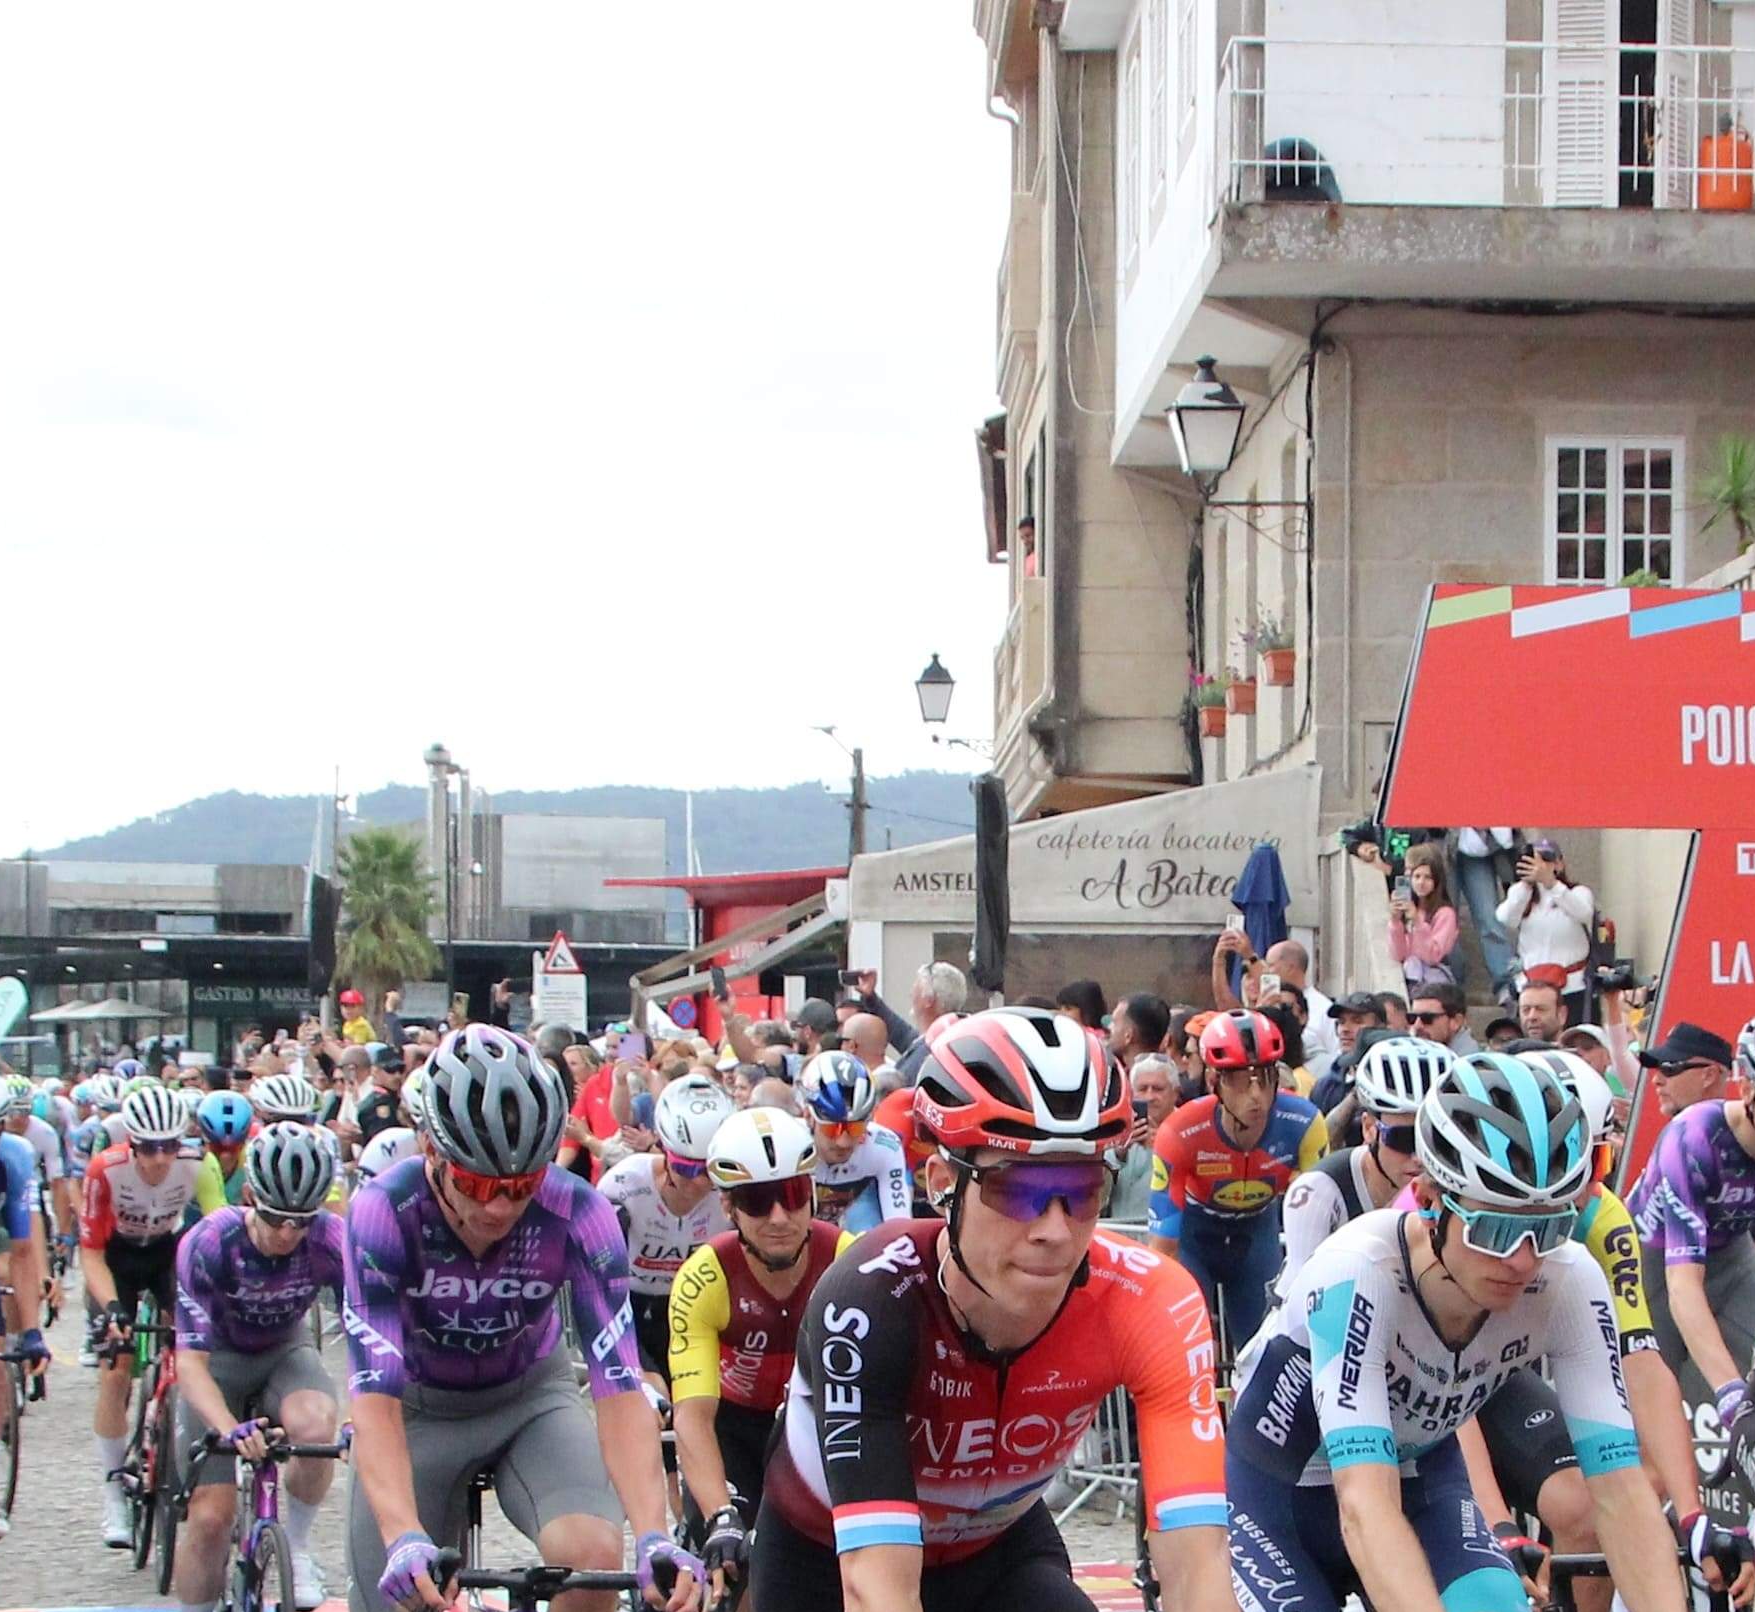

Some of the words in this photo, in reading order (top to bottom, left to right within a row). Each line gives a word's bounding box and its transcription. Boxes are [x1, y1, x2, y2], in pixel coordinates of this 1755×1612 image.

[893, 873, 978, 892] AMSTEL
[1081, 858, 1133, 910] A
[1711, 940, 1752, 985] LA
[259, 987, 314, 1002] MARKE
[1275, 1110, 1312, 1125] TREK
[987, 1138, 1017, 1151] KASK
[889, 1168, 906, 1209] BOSS
[406, 1268, 553, 1305] Jayco
[1166, 1290, 1225, 1442] INEOS
[1336, 1291, 1375, 1413] MERIDA
[821, 1301, 871, 1463] INEOS
[1254, 1351, 1312, 1448] BAHRAIN
[1233, 1512, 1296, 1577] BUSINESS
